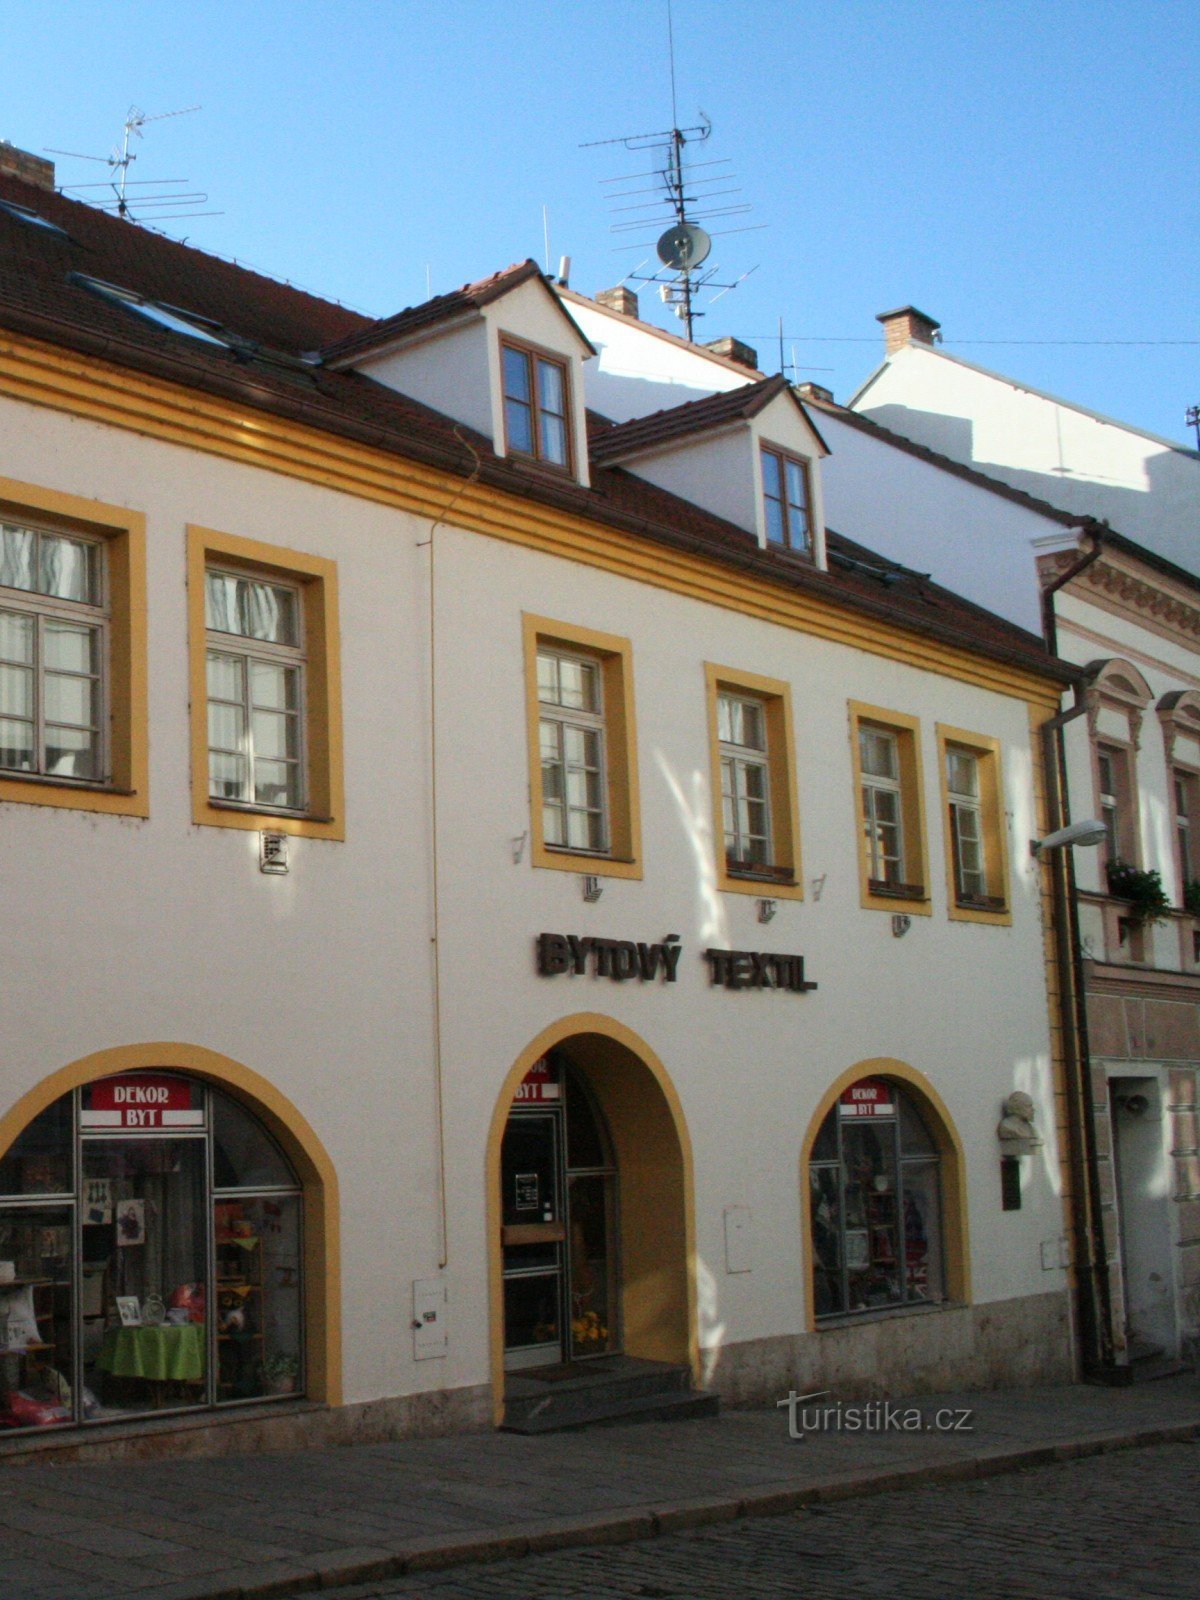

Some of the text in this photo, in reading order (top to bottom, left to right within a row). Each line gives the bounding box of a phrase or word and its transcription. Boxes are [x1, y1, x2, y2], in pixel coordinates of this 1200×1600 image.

[538, 932, 818, 992] BYTOVÝ TEXTIL
[113, 1086, 169, 1103] DEKOR
[126, 1109, 157, 1126] BYT
